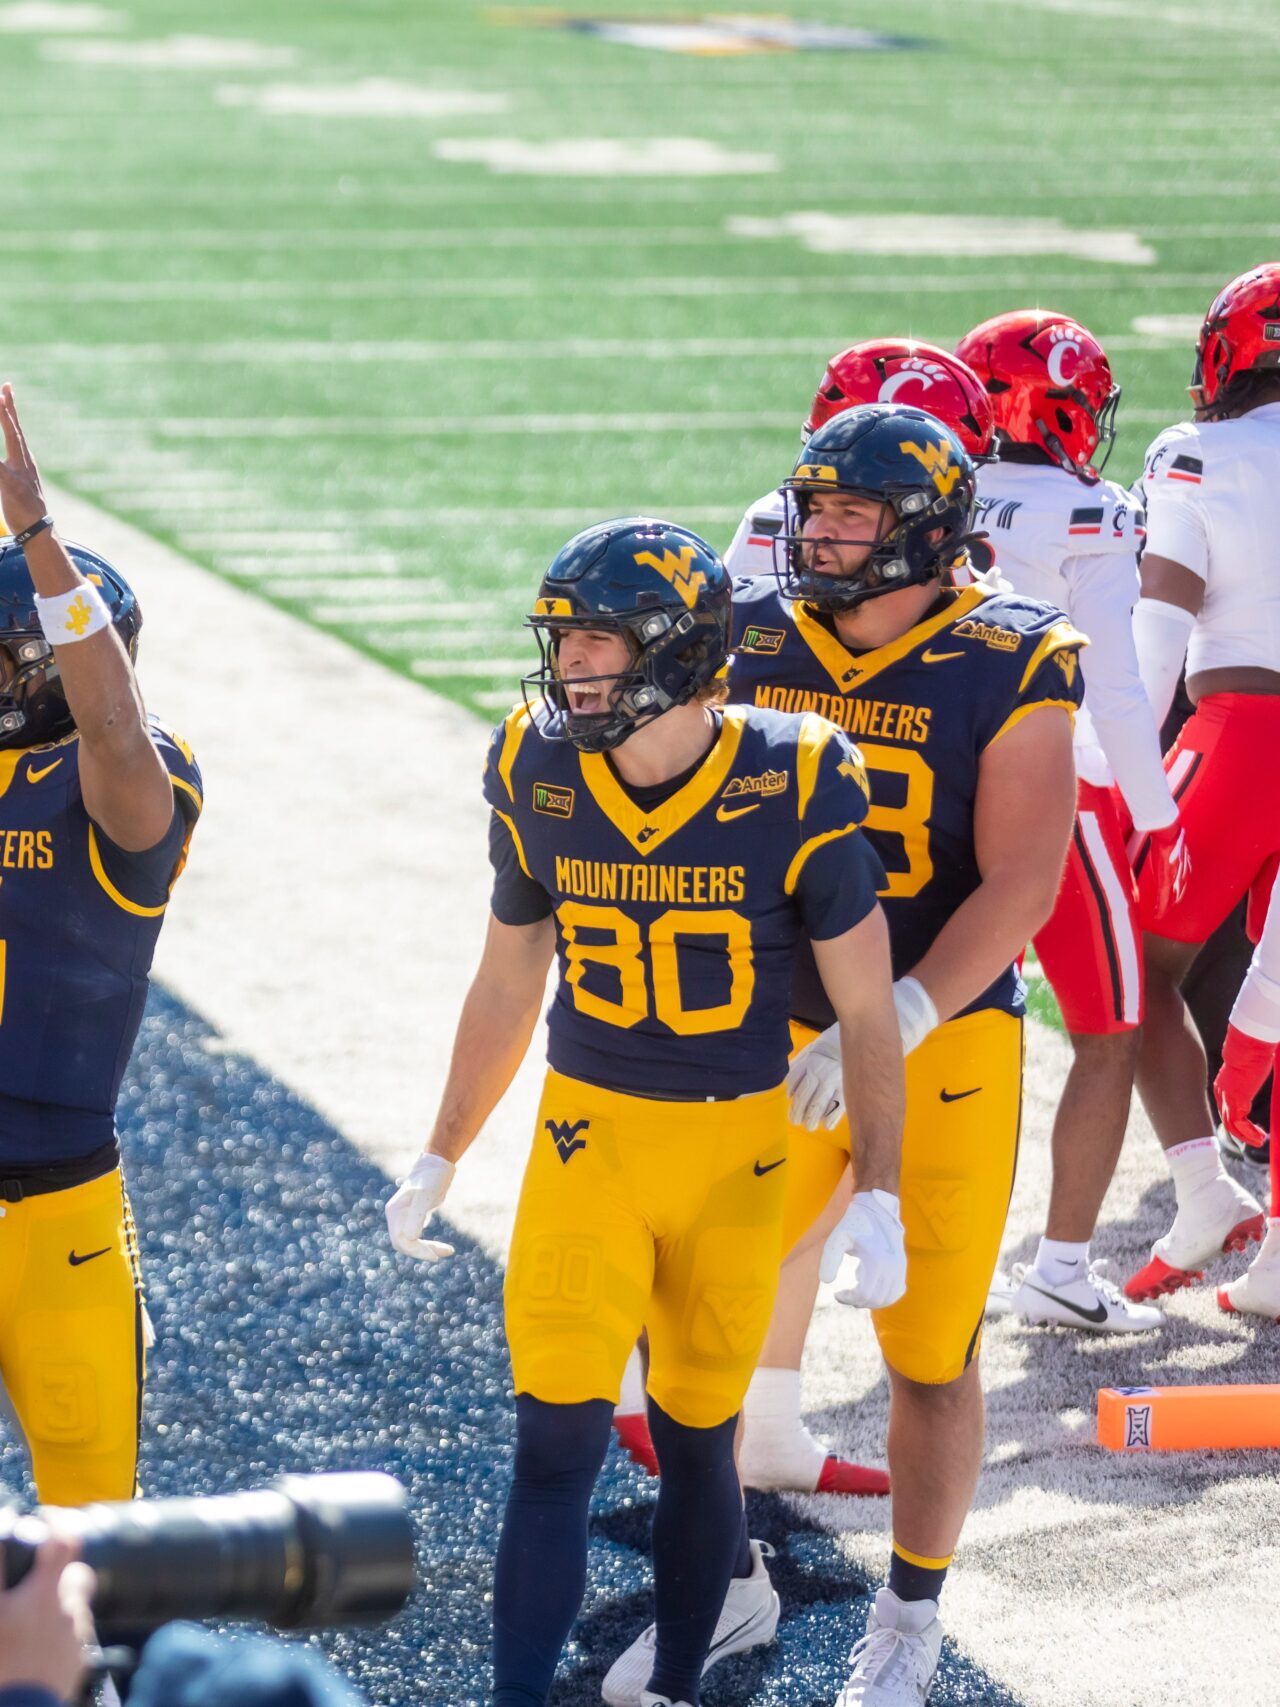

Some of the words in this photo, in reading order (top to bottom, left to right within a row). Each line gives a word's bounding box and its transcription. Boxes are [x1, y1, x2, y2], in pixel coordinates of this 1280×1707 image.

[971, 624, 1020, 645] Antero
[754, 685, 933, 745] MOUNTAINEERS
[554, 855, 746, 904] MOUNTAINEERS
[556, 900, 756, 1036] 80
